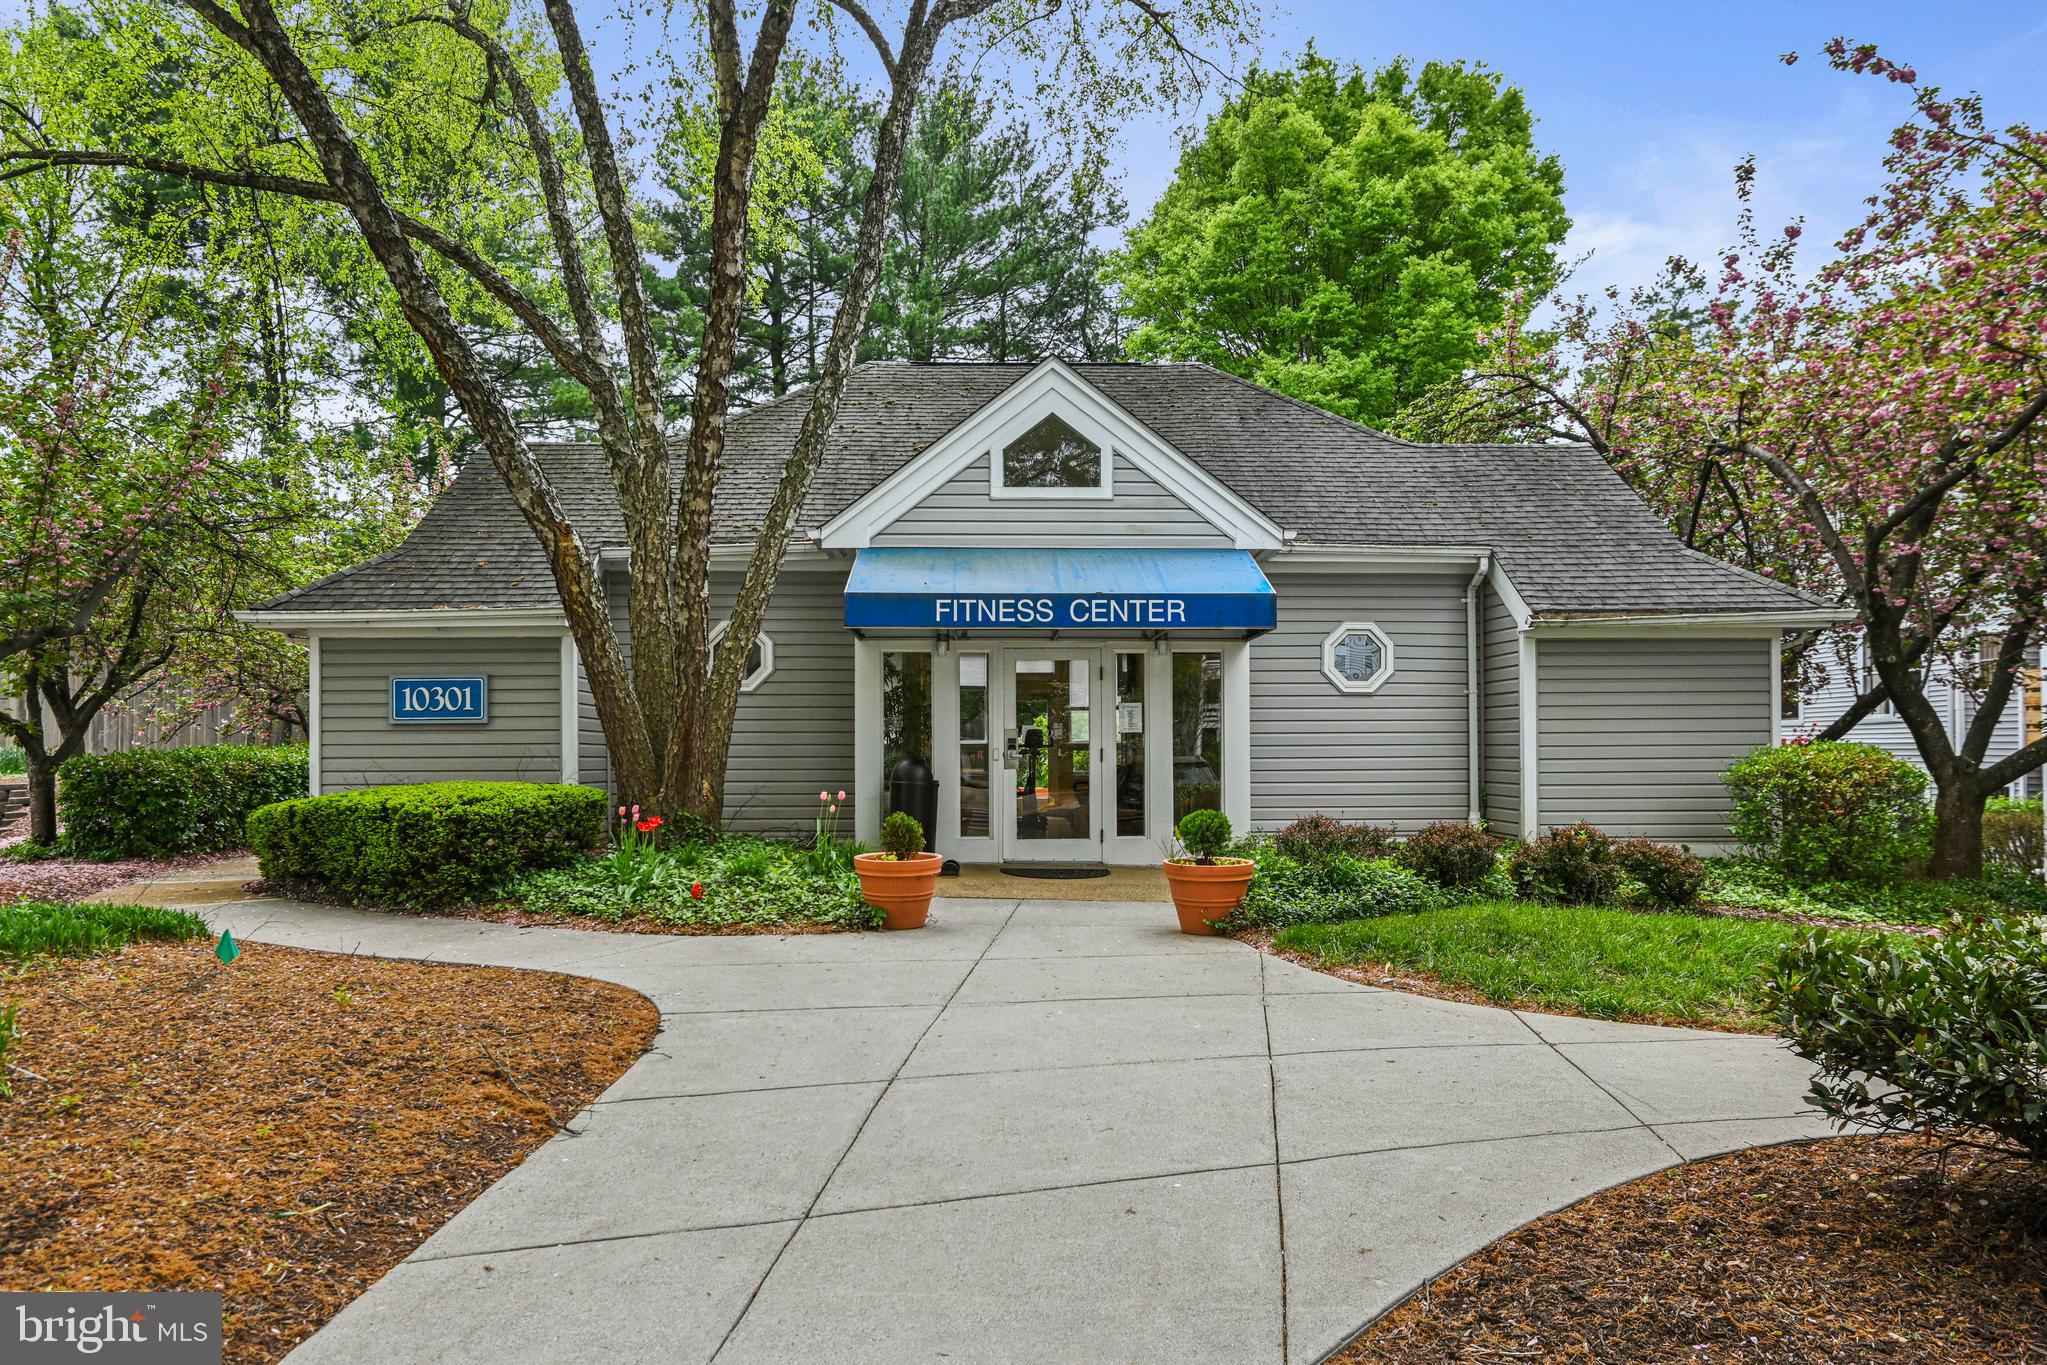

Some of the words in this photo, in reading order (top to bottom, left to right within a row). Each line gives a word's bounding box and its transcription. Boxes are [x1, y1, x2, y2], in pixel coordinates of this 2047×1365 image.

[935, 598, 1054, 622] FITNESS
[1069, 598, 1186, 622] CENTER
[401, 686, 474, 711] 10301
